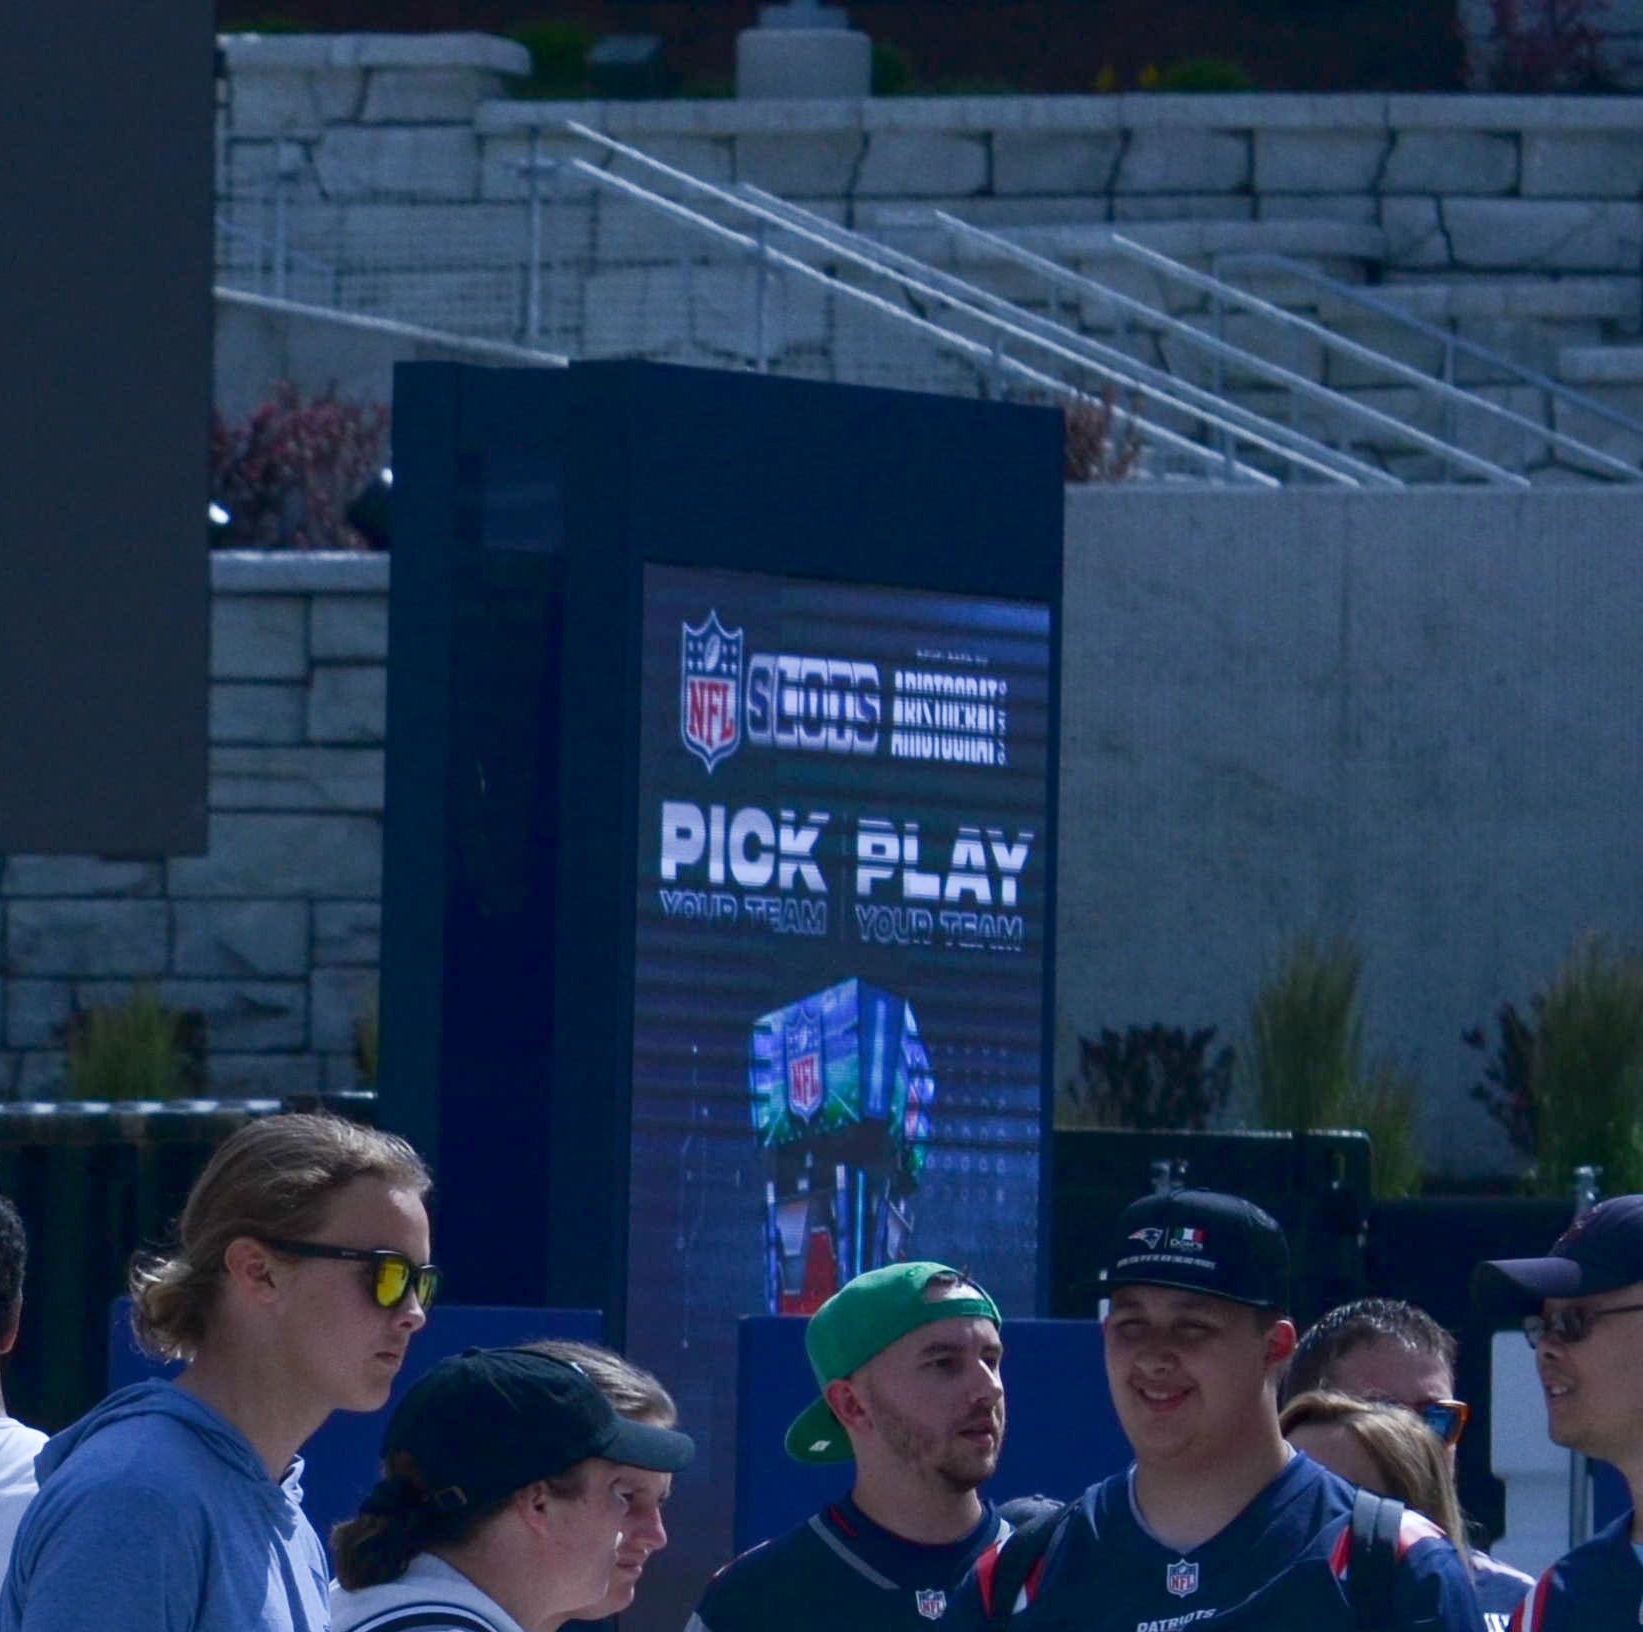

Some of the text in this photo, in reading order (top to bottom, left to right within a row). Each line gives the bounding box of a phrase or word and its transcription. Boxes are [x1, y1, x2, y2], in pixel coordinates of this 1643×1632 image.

[687, 678, 734, 746] NFL
[747, 653, 881, 753] SLOTS
[661, 800, 830, 894] PICK
[856, 818, 1035, 907] PLAY
[660, 889, 827, 936] YOUR TEAM
[855, 904, 1023, 952] YOUR TEAM
[1170, 1574, 1195, 1591] NFL
